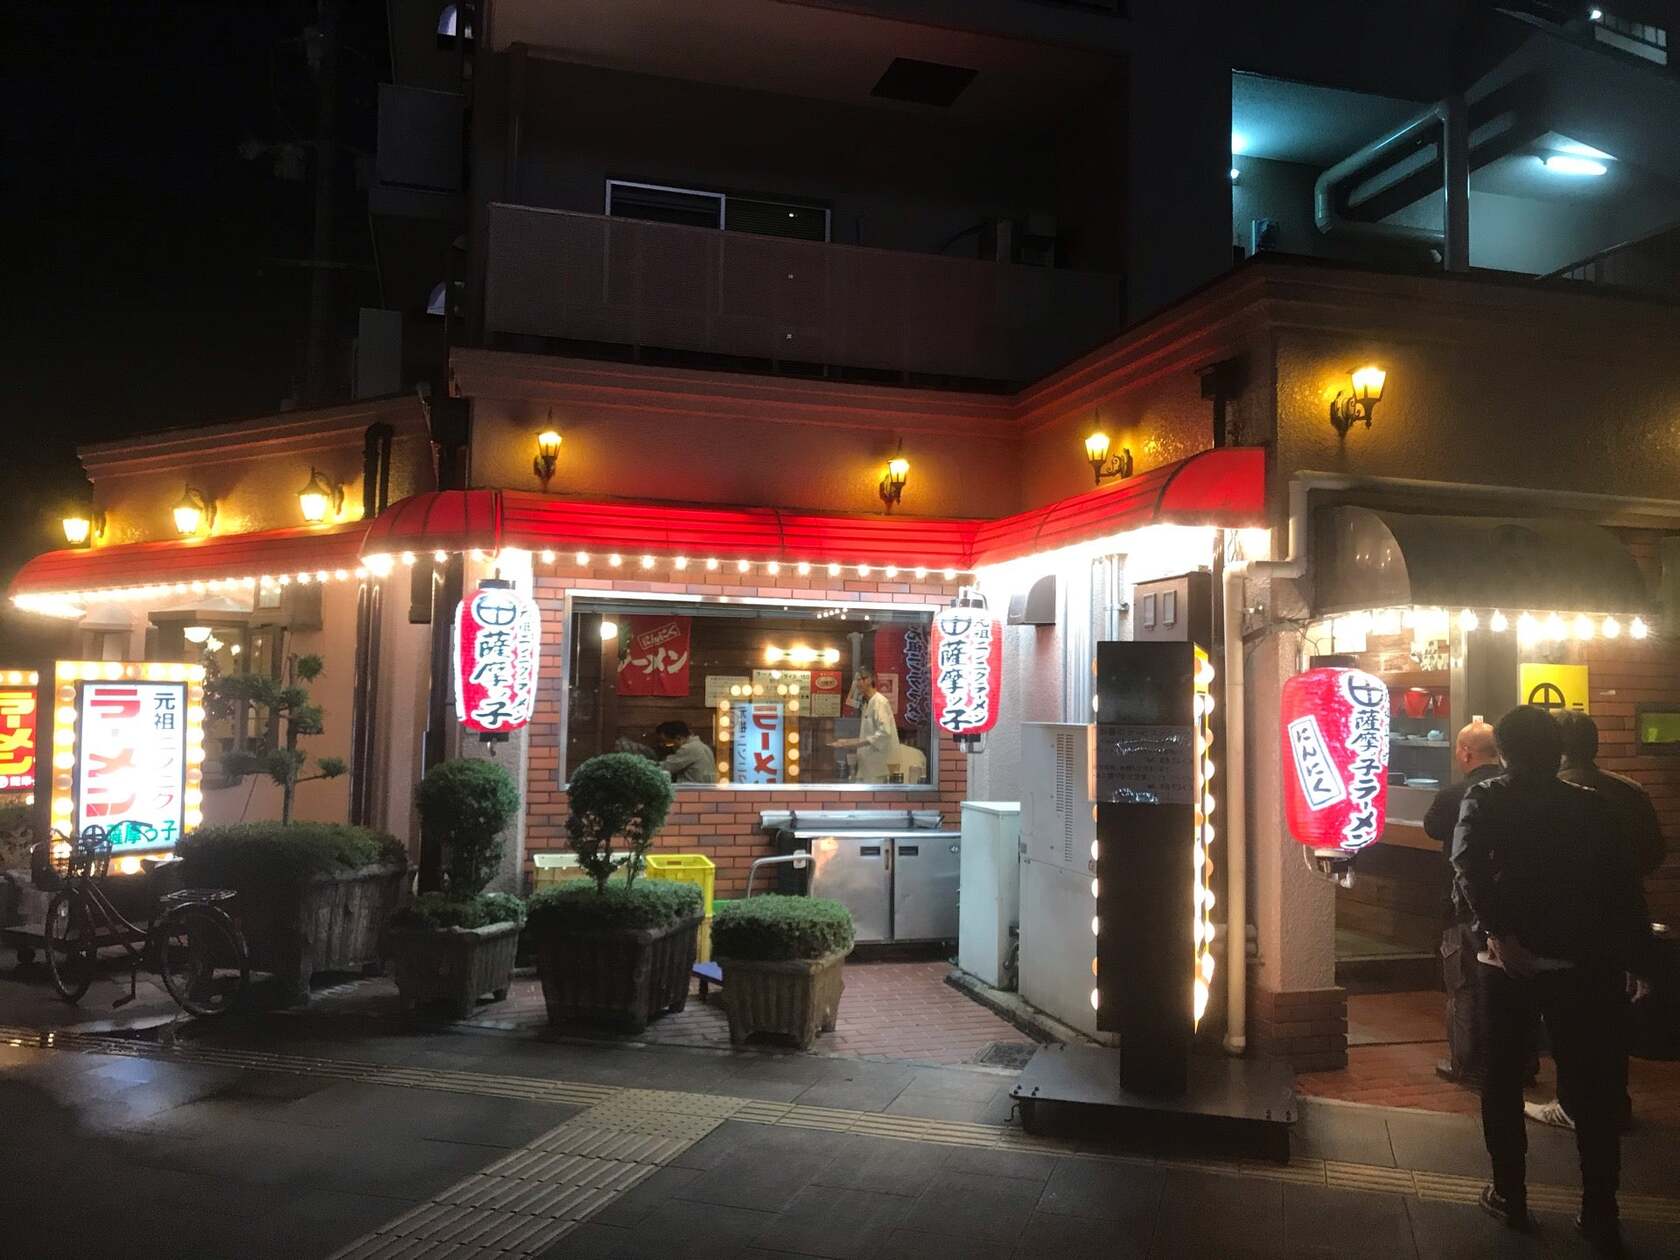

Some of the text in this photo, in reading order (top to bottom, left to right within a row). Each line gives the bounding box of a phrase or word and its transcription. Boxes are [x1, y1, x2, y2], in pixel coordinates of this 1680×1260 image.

[86, 688, 141, 817] ラメン
[1296, 727, 1332, 792] にんにく
[1345, 709, 1381, 847] 薩摩子ラーメン
